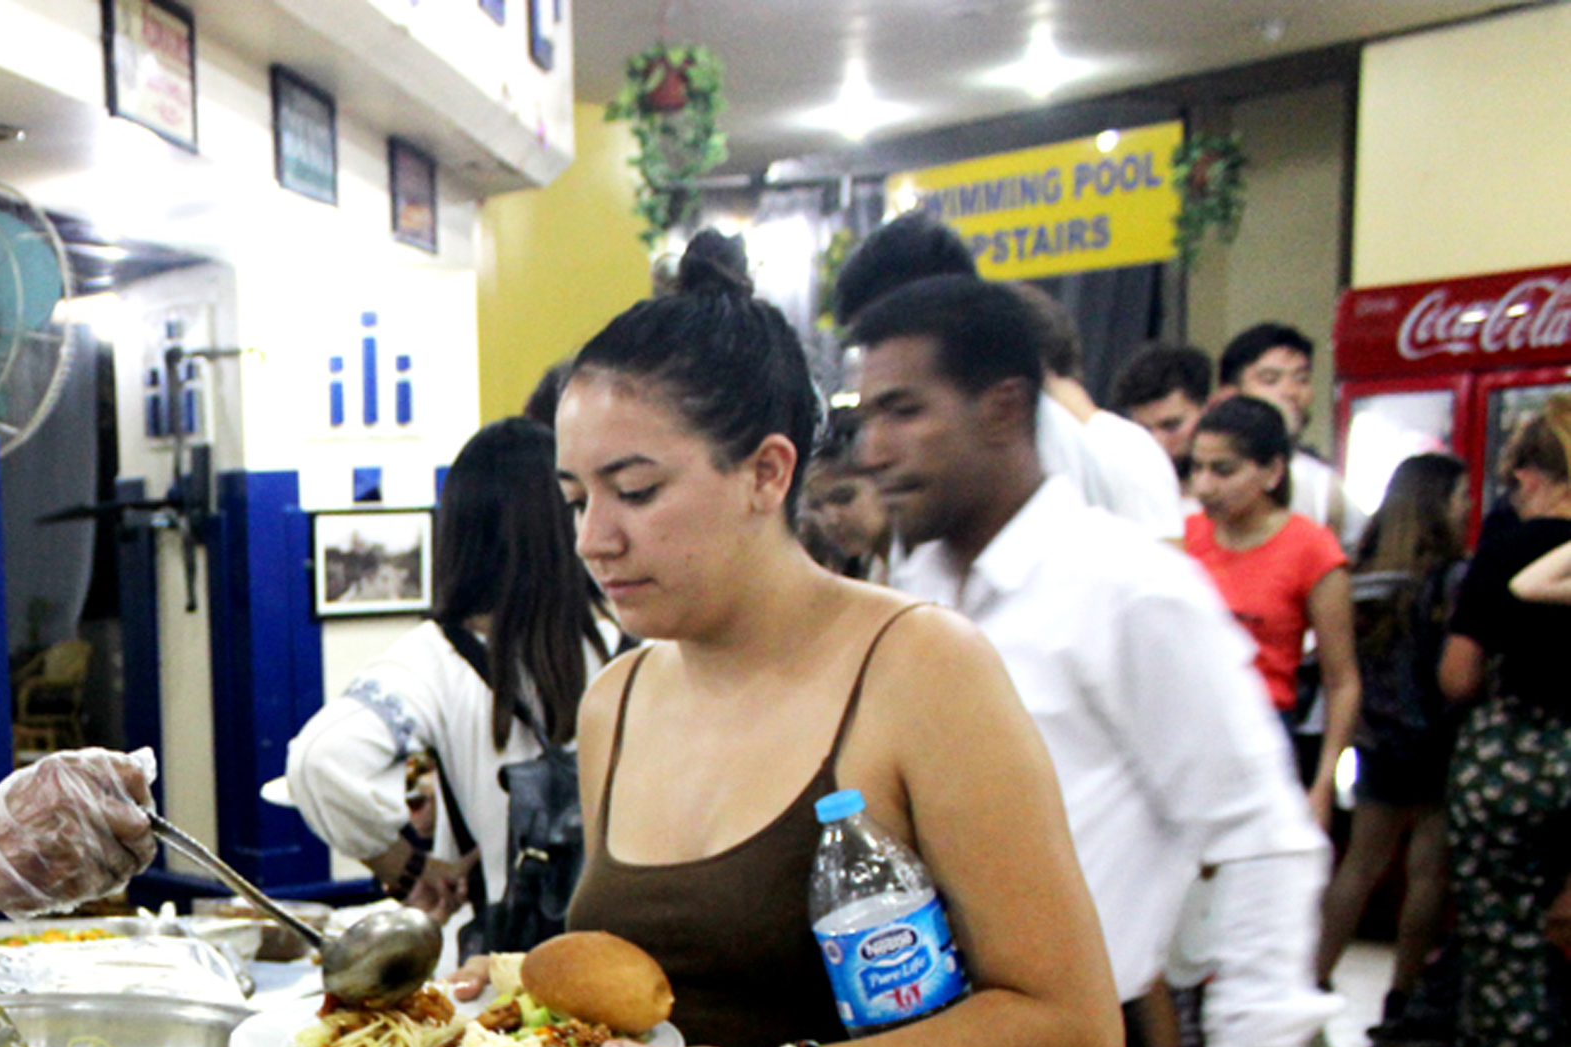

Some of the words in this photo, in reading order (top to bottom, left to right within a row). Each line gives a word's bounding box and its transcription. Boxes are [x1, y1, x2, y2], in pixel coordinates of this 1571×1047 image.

[919, 168, 1063, 216] WIMMING
[1073, 152, 1161, 200] POOL
[963, 214, 1111, 264] PSTAIRS
[868, 970, 900, 989] Pure
[902, 956, 926, 978] Life
